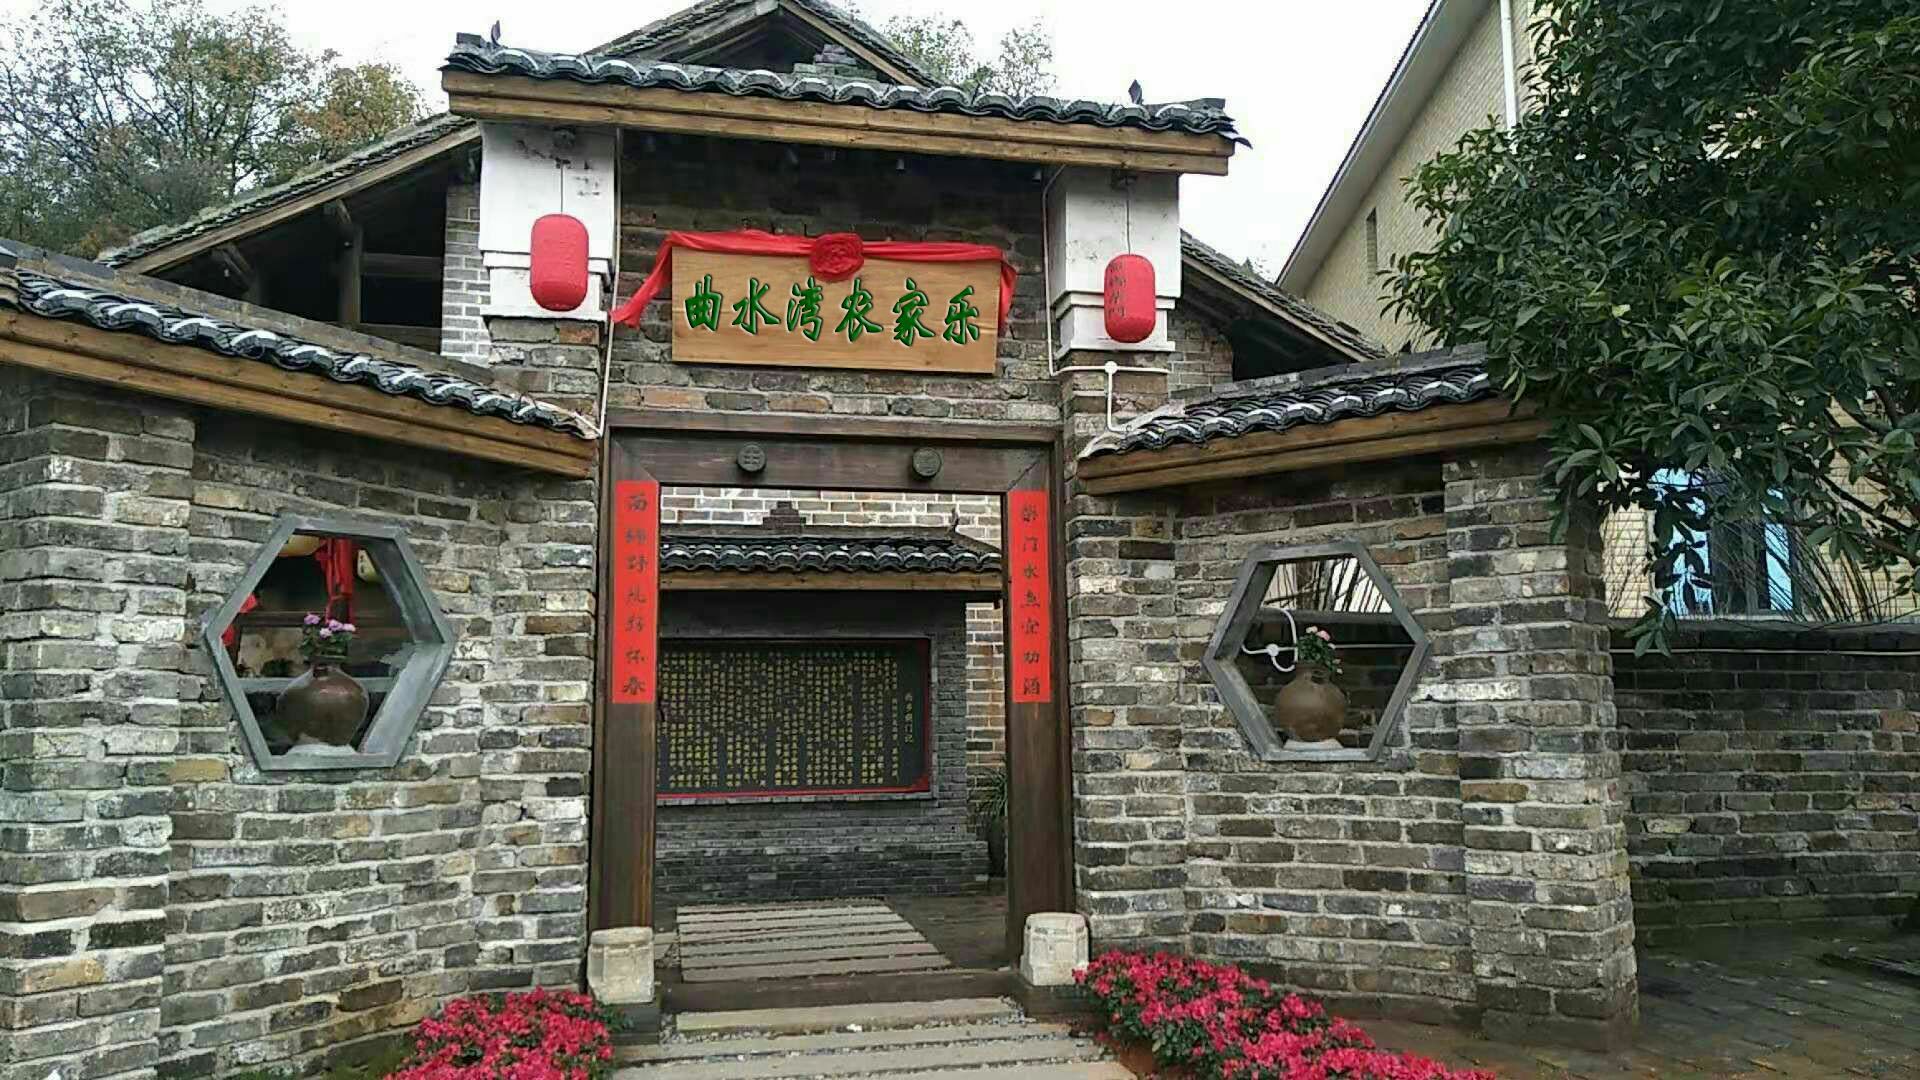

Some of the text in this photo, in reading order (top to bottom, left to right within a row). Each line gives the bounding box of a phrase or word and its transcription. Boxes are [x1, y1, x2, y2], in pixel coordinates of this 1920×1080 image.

[684, 274, 980, 346] 曲水湾农家乐
